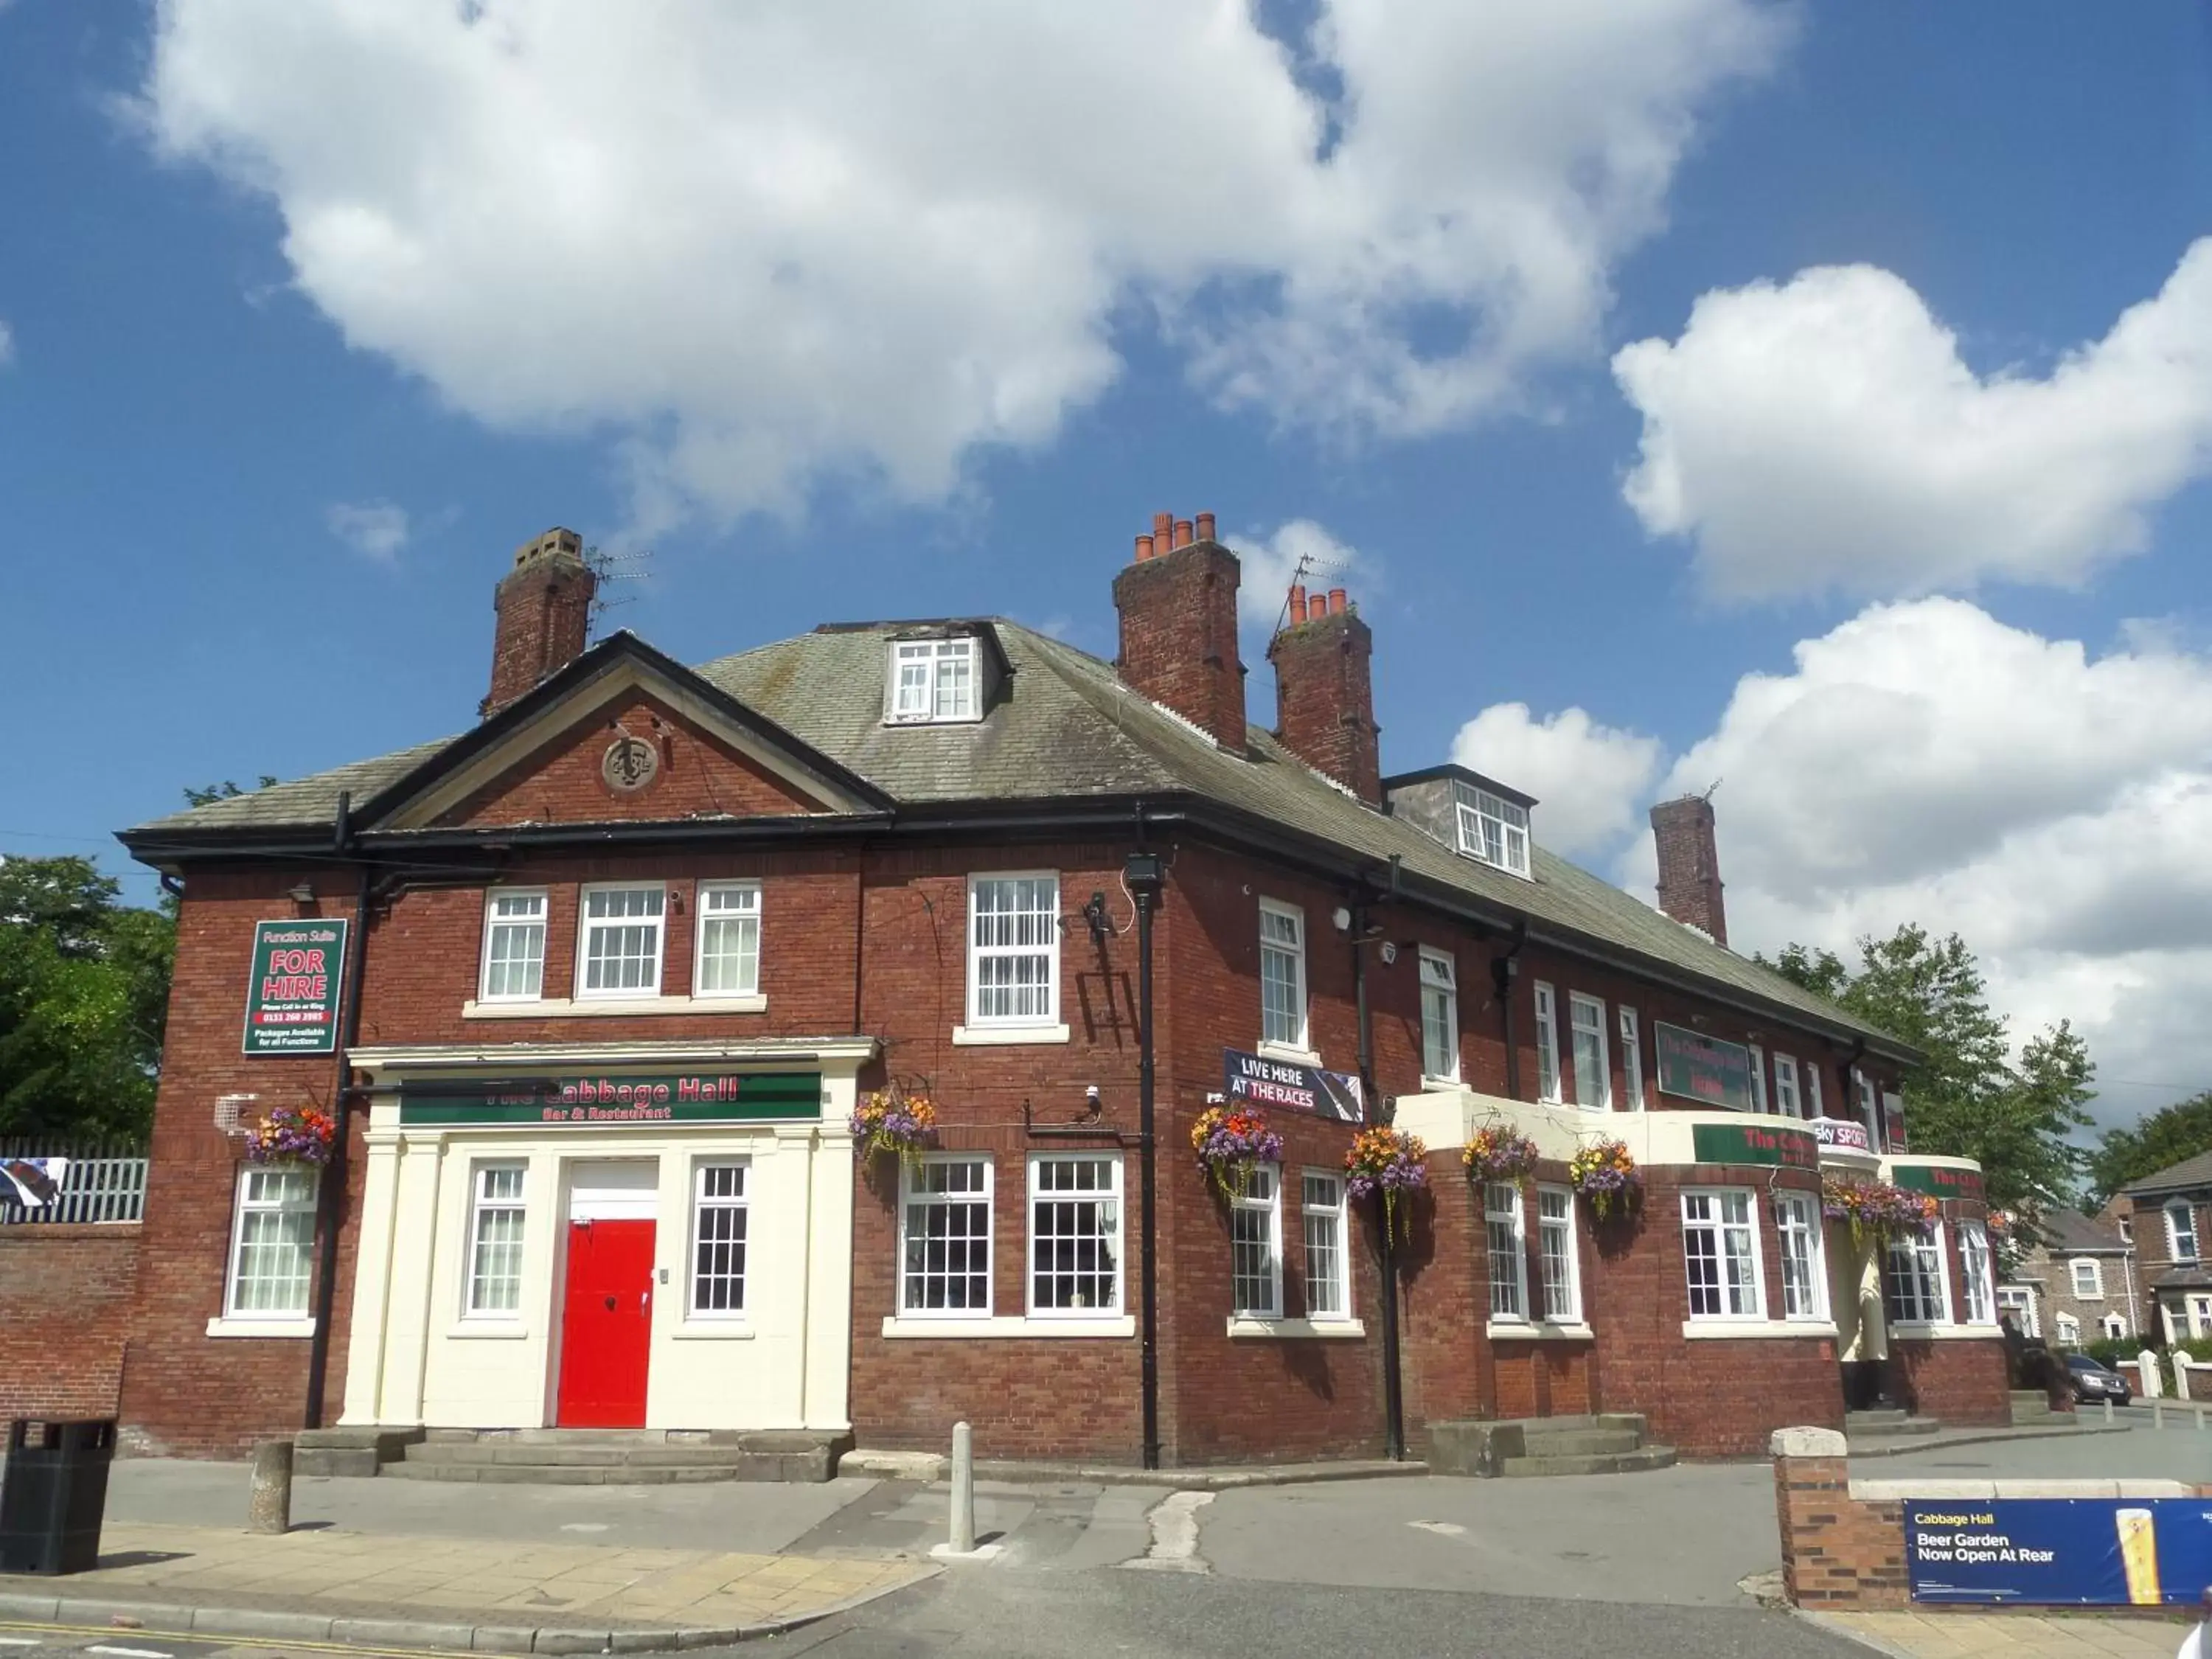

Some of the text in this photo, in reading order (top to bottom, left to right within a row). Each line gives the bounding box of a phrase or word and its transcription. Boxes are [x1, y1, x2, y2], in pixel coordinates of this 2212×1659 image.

[263, 930, 337, 943] Function Suite
[269, 949, 325, 974] FOR
[262, 975, 328, 1001] HIRE
[254, 1029, 290, 1037] Packages
[282, 1037, 319, 1046] Functions
[1242, 1058, 1302, 1086] LIVE HERE
[678, 1077, 739, 1103] Hall
[1232, 1078, 1314, 1107] AT THE RACES
[542, 1106, 672, 1121] Bar & Restaurant
[1745, 1128, 1775, 1150] The
[1815, 1124, 1834, 1144] sky
[1915, 1513, 1994, 1526] Cabbage Hall
[1917, 1533, 2009, 1546] Beer Garden
[1918, 1548, 2055, 1564] Now Open At Rear
